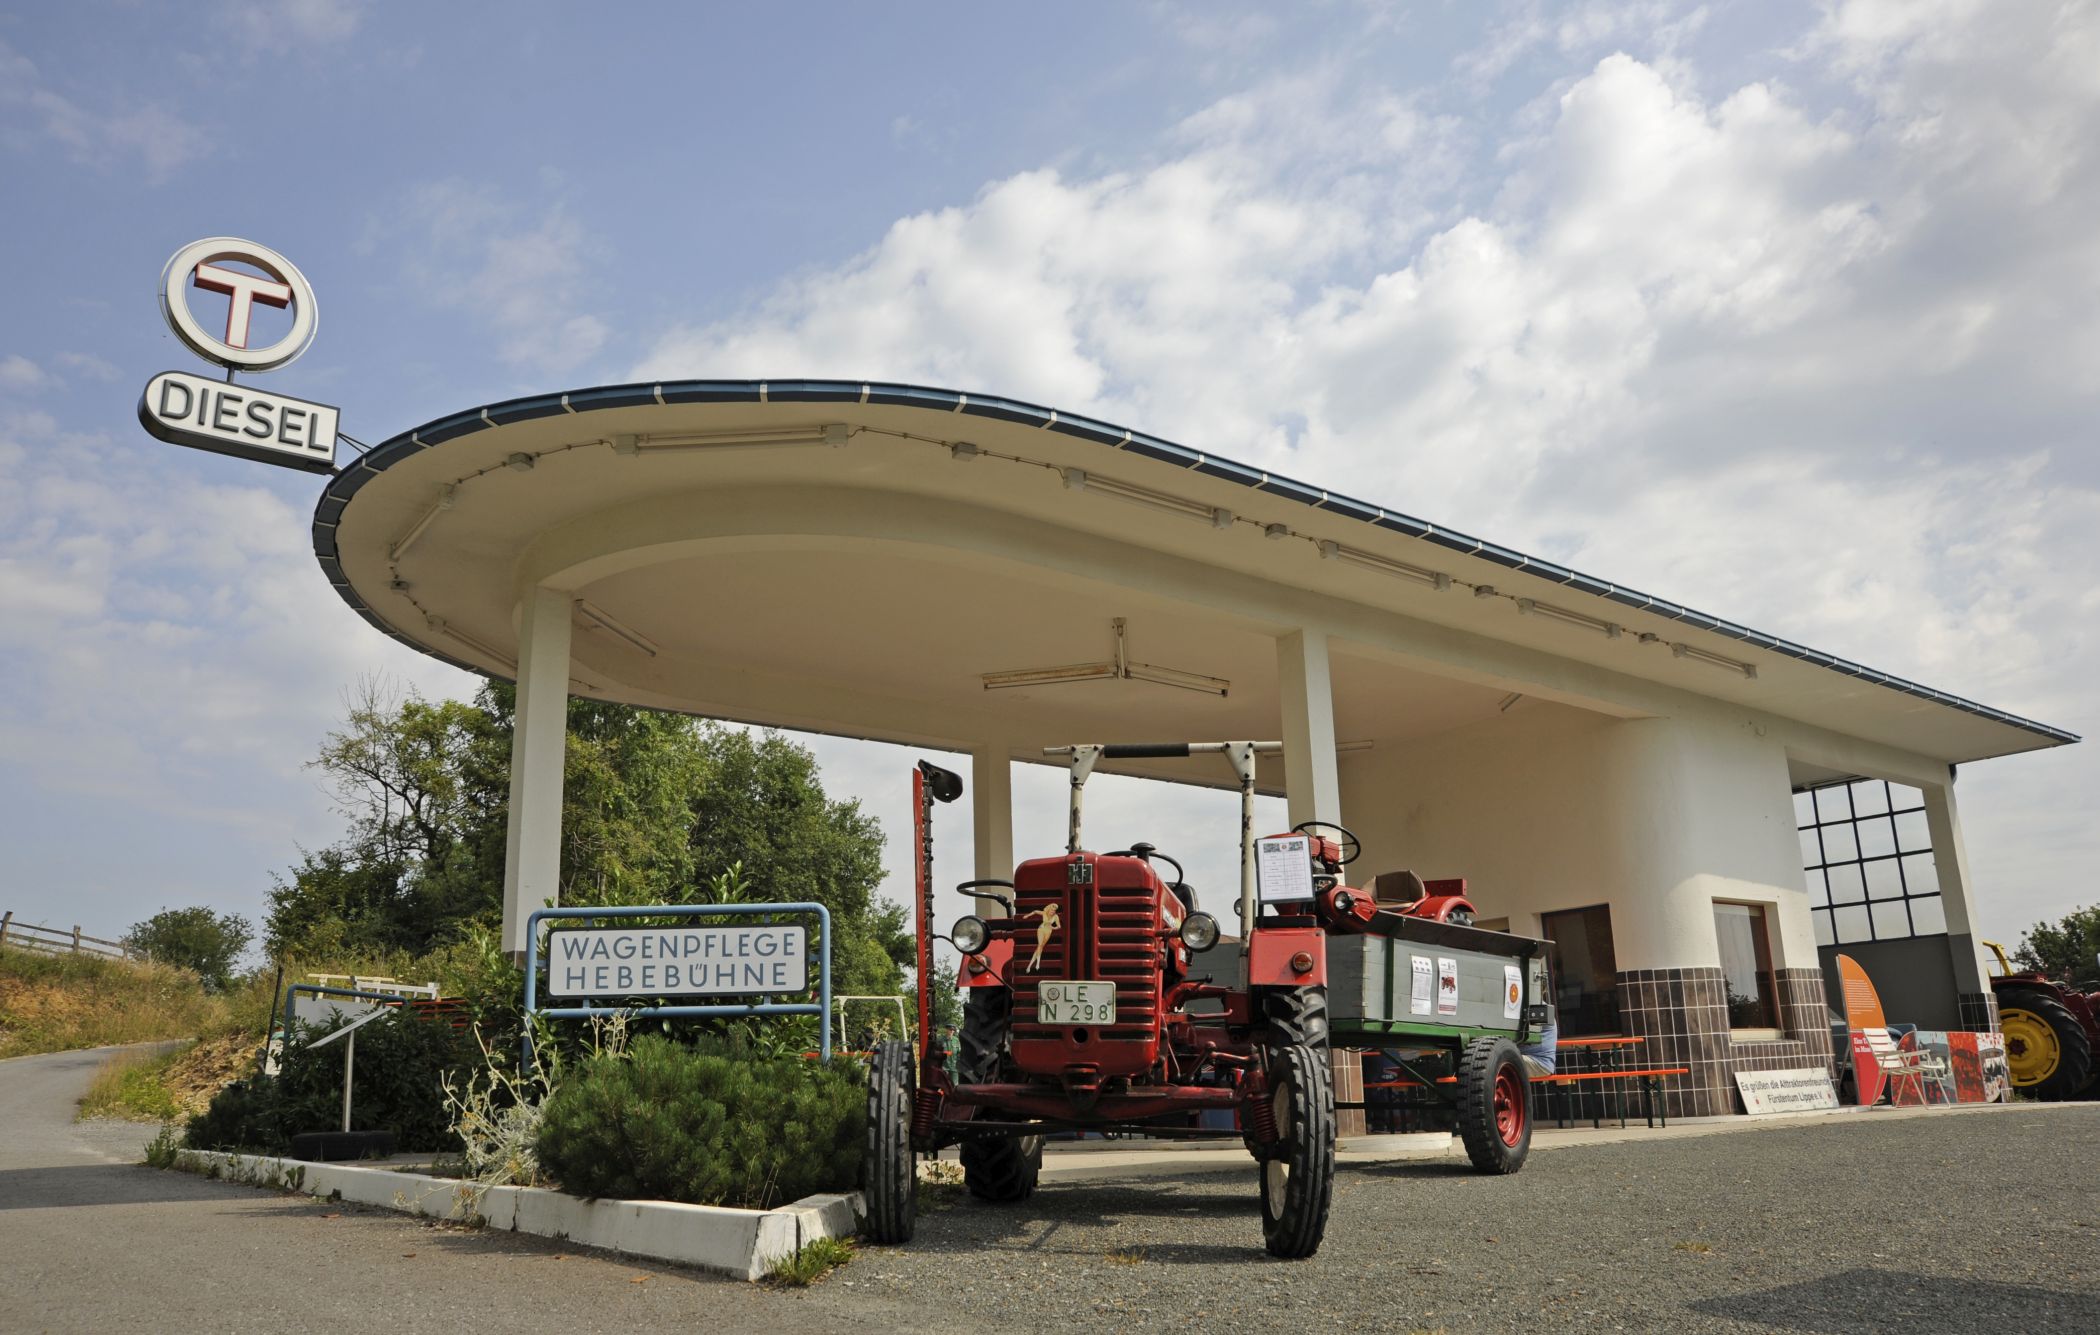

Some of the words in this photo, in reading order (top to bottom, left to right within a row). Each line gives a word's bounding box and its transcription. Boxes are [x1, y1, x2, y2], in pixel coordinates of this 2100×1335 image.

[193, 262, 291, 349] T
[159, 379, 330, 452] DIESEL
[562, 932, 796, 961] WAGENPFLEGE
[565, 962, 787, 990] HEBEBÜHNE
[1064, 986, 1088, 1002] LE
[1045, 1004, 1057, 1020] N
[1070, 1004, 1108, 1020] 298
